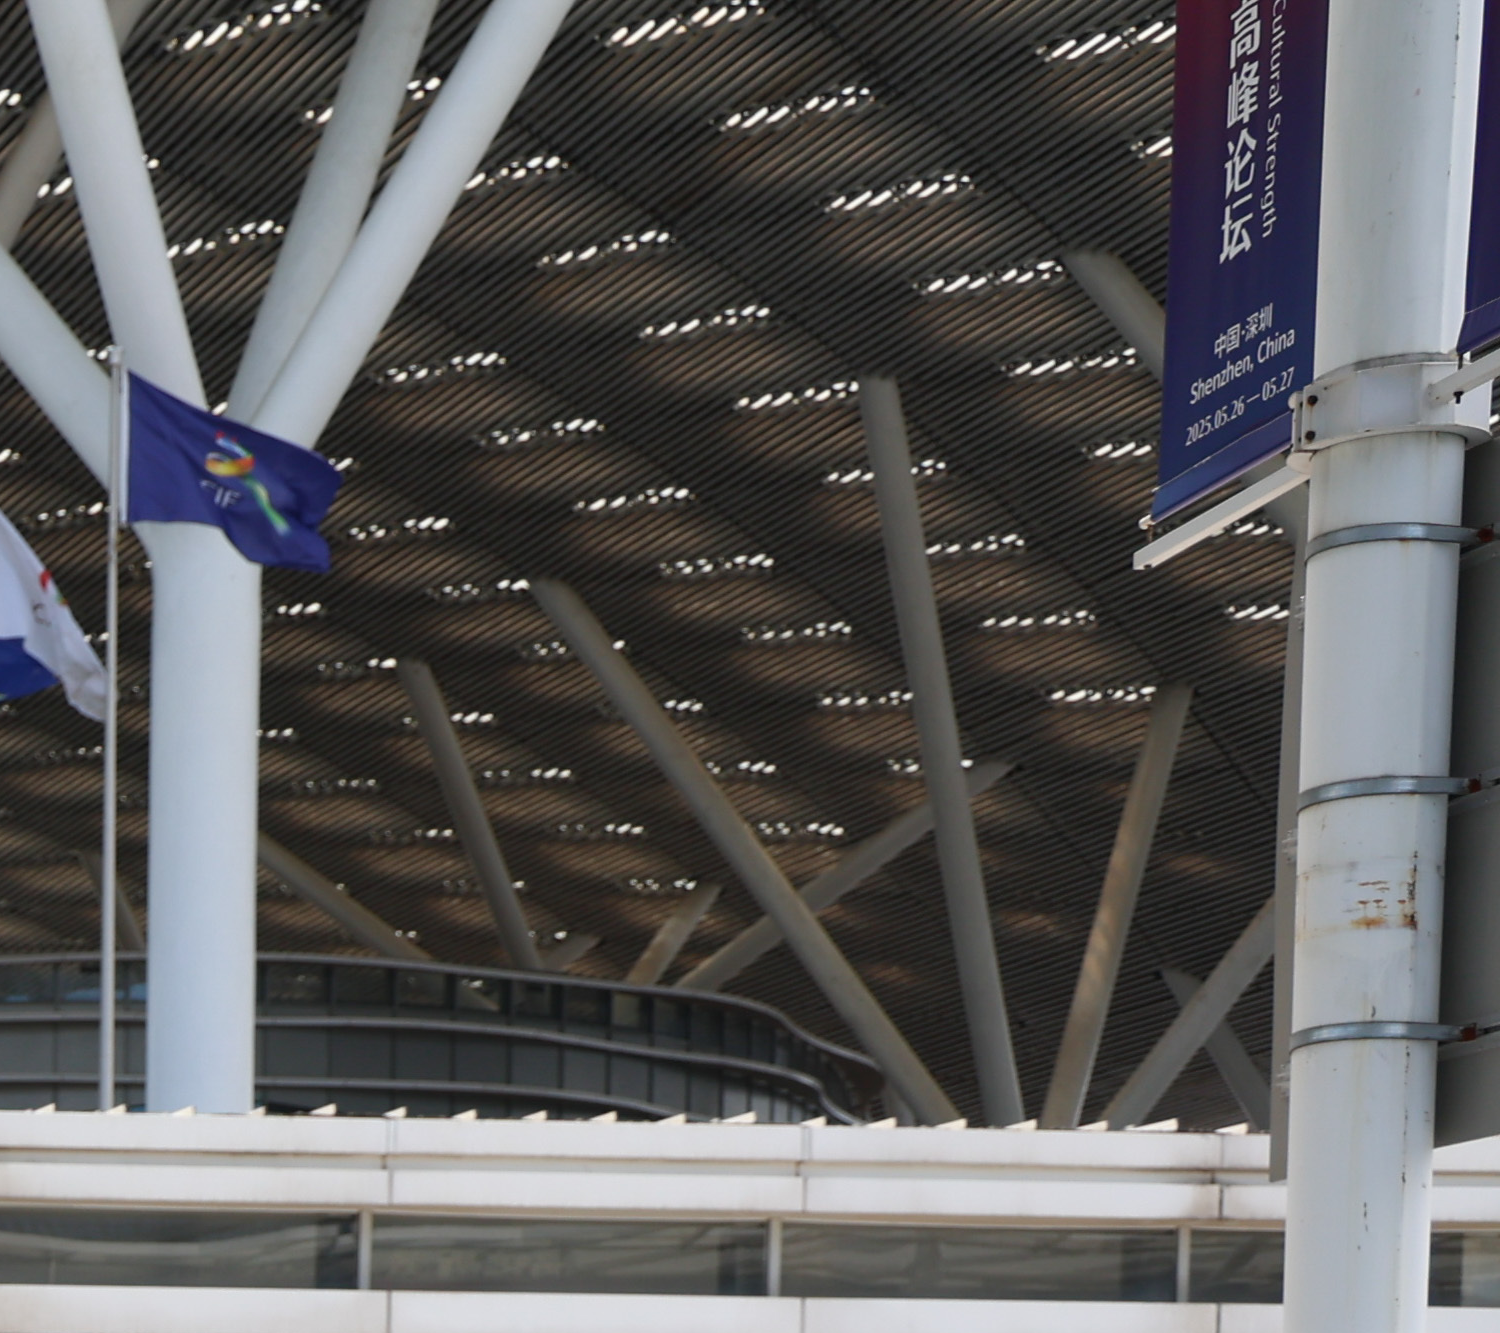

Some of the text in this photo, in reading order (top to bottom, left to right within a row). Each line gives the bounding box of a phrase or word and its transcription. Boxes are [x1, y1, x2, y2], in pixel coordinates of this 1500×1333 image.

[1220, 0, 1261, 264] 高峰论坛
[1260, 112, 1281, 238] Strength
[1189, 328, 1295, 404] Shenzhen, China
